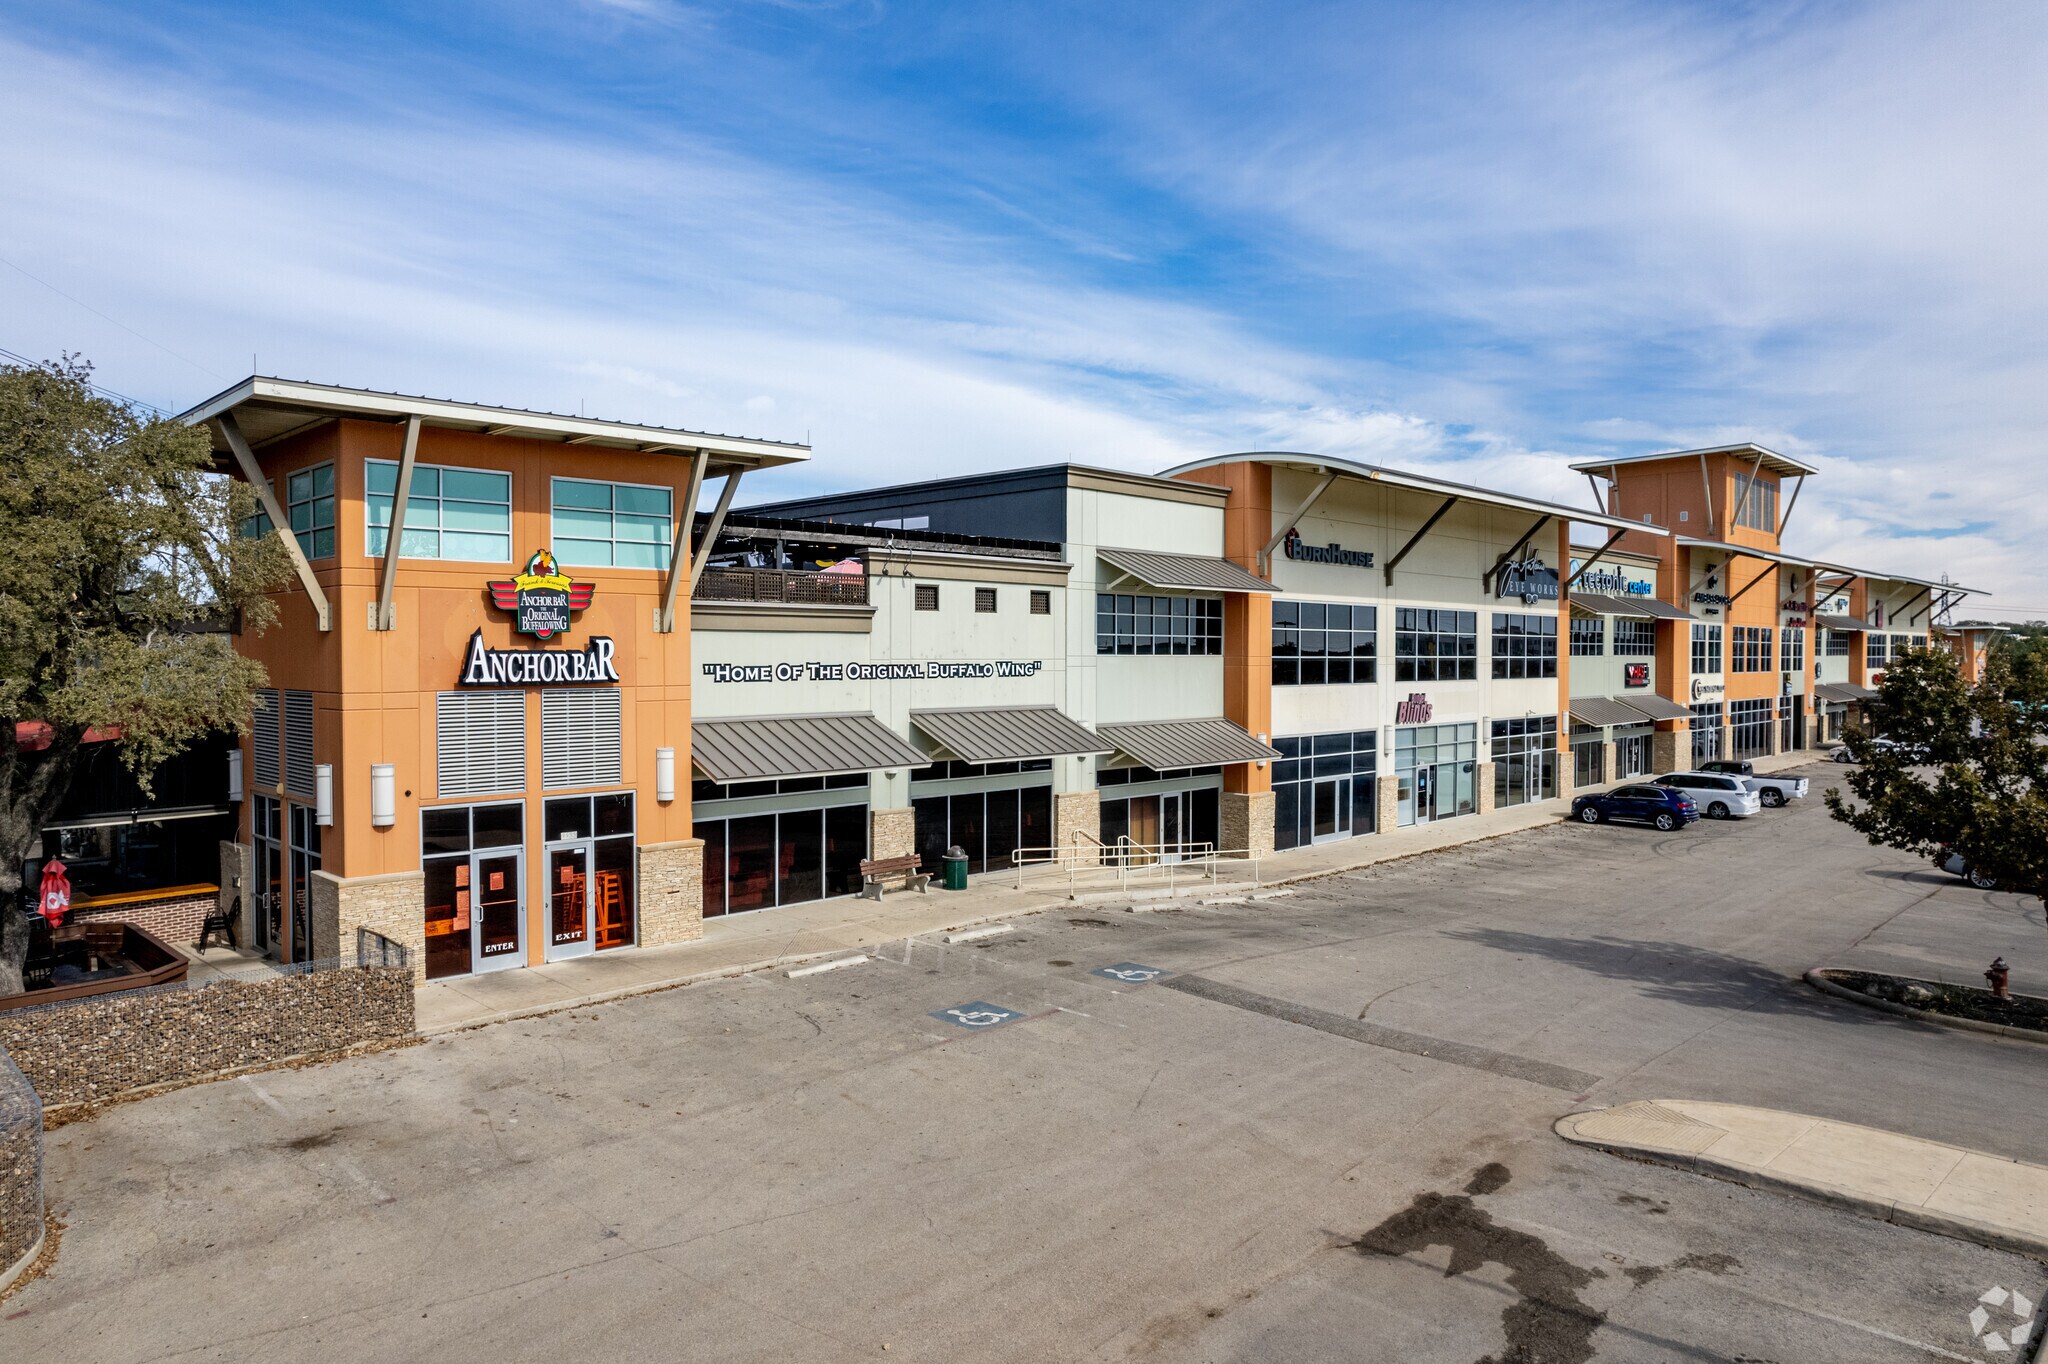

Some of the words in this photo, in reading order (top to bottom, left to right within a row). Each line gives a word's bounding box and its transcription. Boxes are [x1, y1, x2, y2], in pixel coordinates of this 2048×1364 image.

[1509, 580, 1526, 593] EYE
[1529, 582, 1559, 596] WORKS
[1582, 566, 1628, 592] tectonic
[1628, 580, 1653, 594] center
[520, 591, 552, 607] ANCHOR
[552, 593, 568, 607] BAR
[527, 607, 560, 621] ORIGINAL
[521, 616, 550, 631] BUFFALO
[462, 631, 570, 684] ANCHOR
[571, 637, 620, 683] BAR
[1396, 701, 1433, 725] Blinds
[555, 930, 583, 942] EXIT
[485, 941, 514, 954] ENTER
